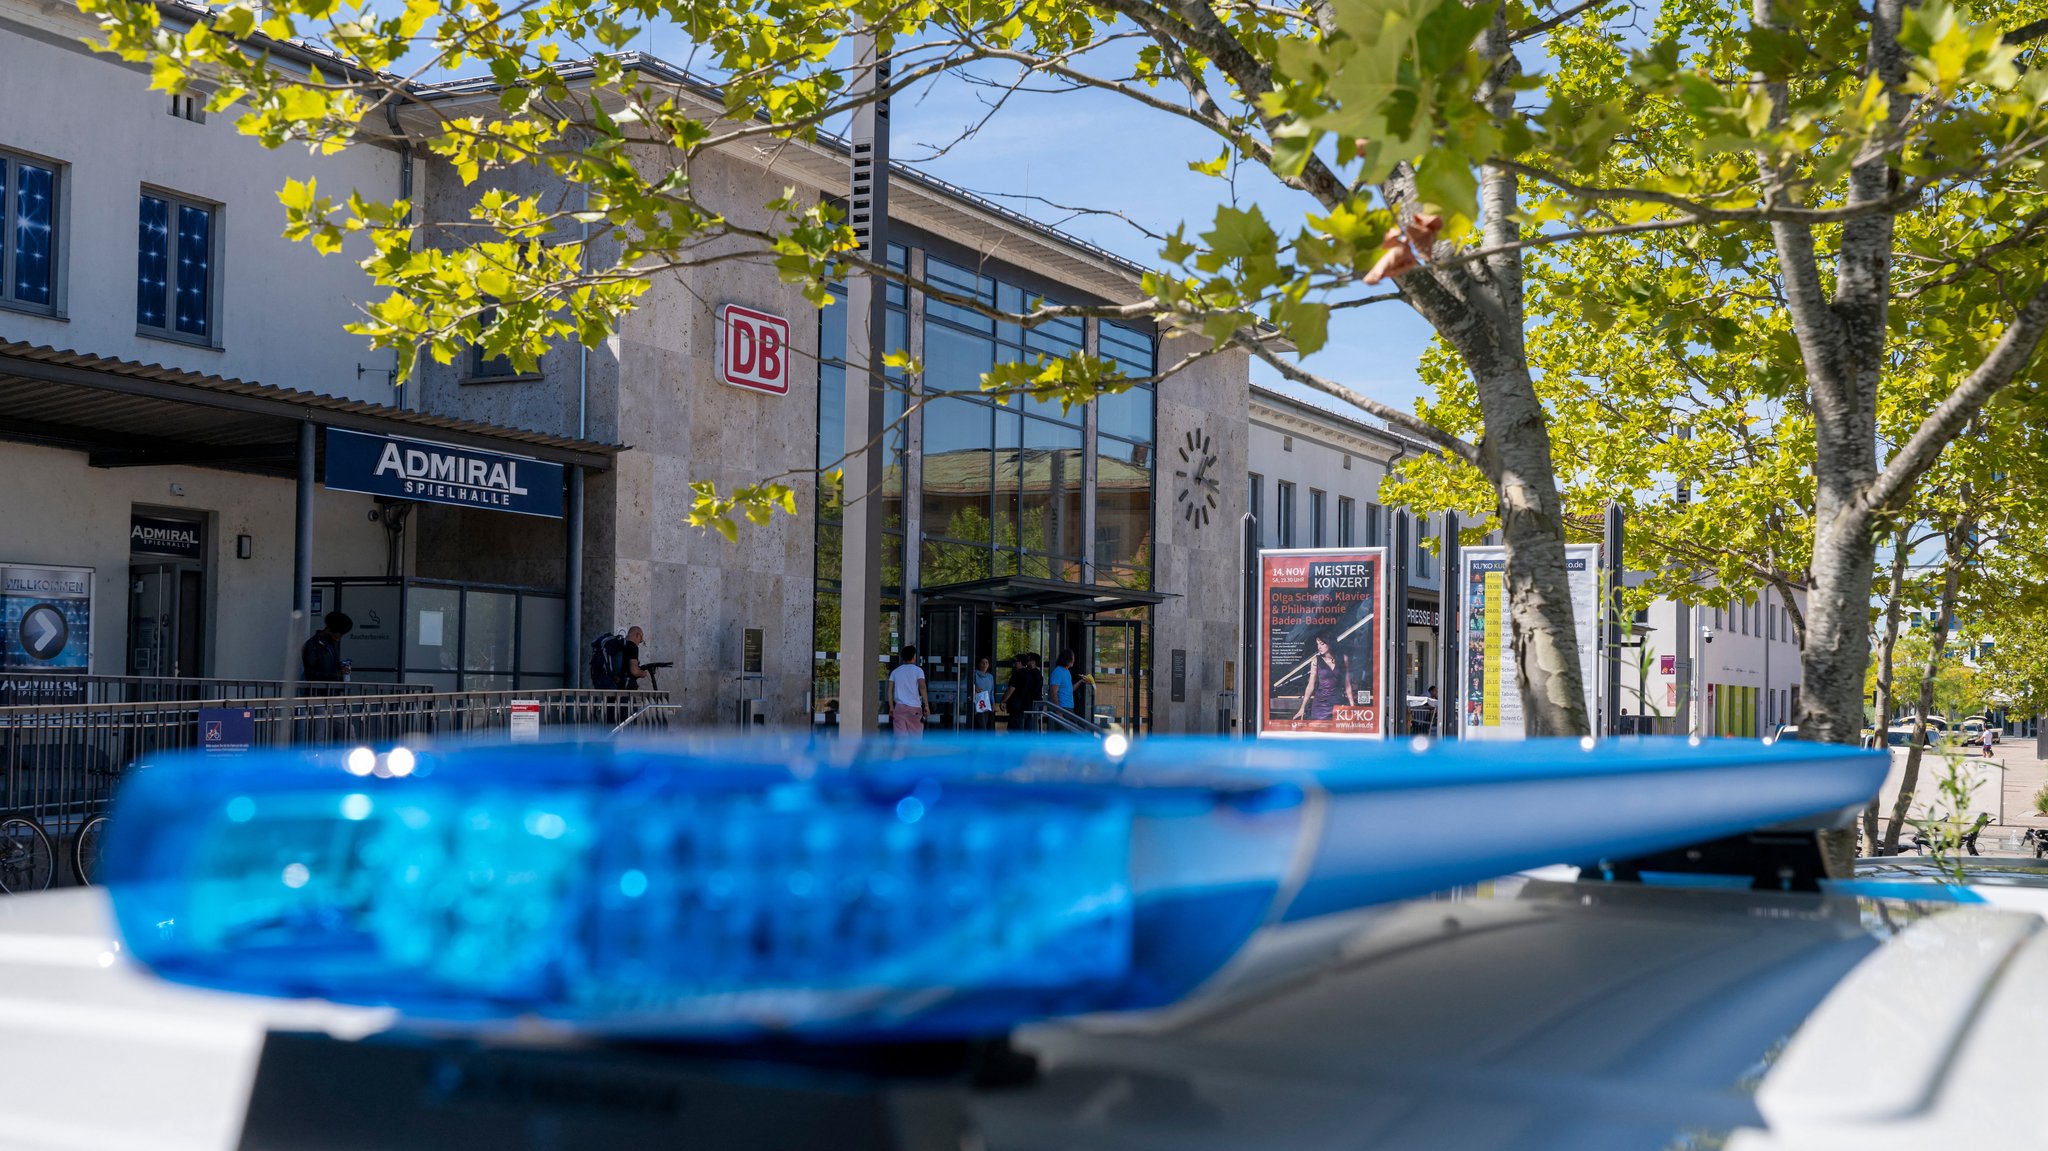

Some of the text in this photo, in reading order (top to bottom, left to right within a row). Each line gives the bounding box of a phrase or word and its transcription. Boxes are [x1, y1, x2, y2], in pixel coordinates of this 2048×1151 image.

[733, 319, 780, 380] DB
[373, 442, 528, 495] ADMIRAL
[404, 481, 510, 506] SPIELHALLE
[131, 525, 198, 544] ADMIRAL
[144, 540, 190, 549] SPIELHALLE
[1273, 567, 1306, 576] 14. NOV
[1314, 565, 1369, 576] MEISTER-
[7, 579, 84, 592] WILLKOMMEN
[1314, 577, 1370, 588] KONZERT
[1272, 592, 1370, 604] Olga Scheps, Klavier
[1272, 604, 1346, 614] & Philharmonie
[1272, 616, 1336, 625] Baden-Baden
[1335, 721, 1374, 729] www.kuko.de
